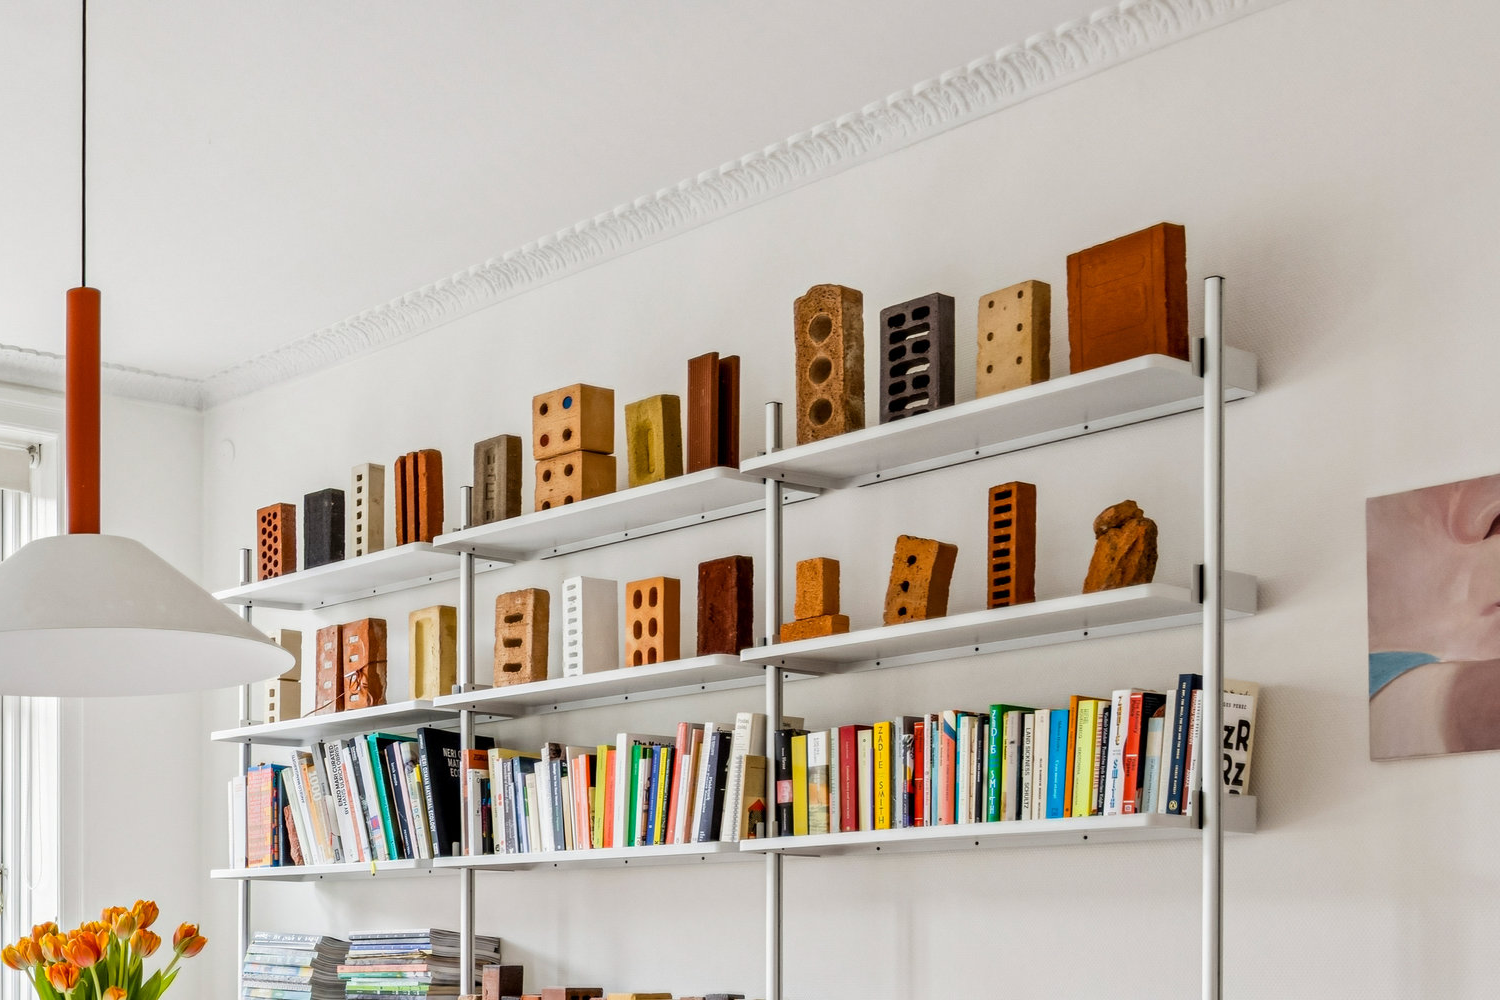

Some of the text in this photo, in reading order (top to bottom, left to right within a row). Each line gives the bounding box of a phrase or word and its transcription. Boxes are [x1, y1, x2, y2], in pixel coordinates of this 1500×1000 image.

[1232, 702, 1247, 710] PEREC
[328, 744, 337, 773] CURATED
[332, 743, 341, 765] OBRIST
[989, 709, 998, 815] ZADIE SMITH
[309, 770, 321, 801] 1000
[337, 766, 345, 788] ULRICH
[424, 784, 433, 809] MATERIAL
[343, 806, 349, 814] BY
[428, 809, 437, 831] ECOLOGY
